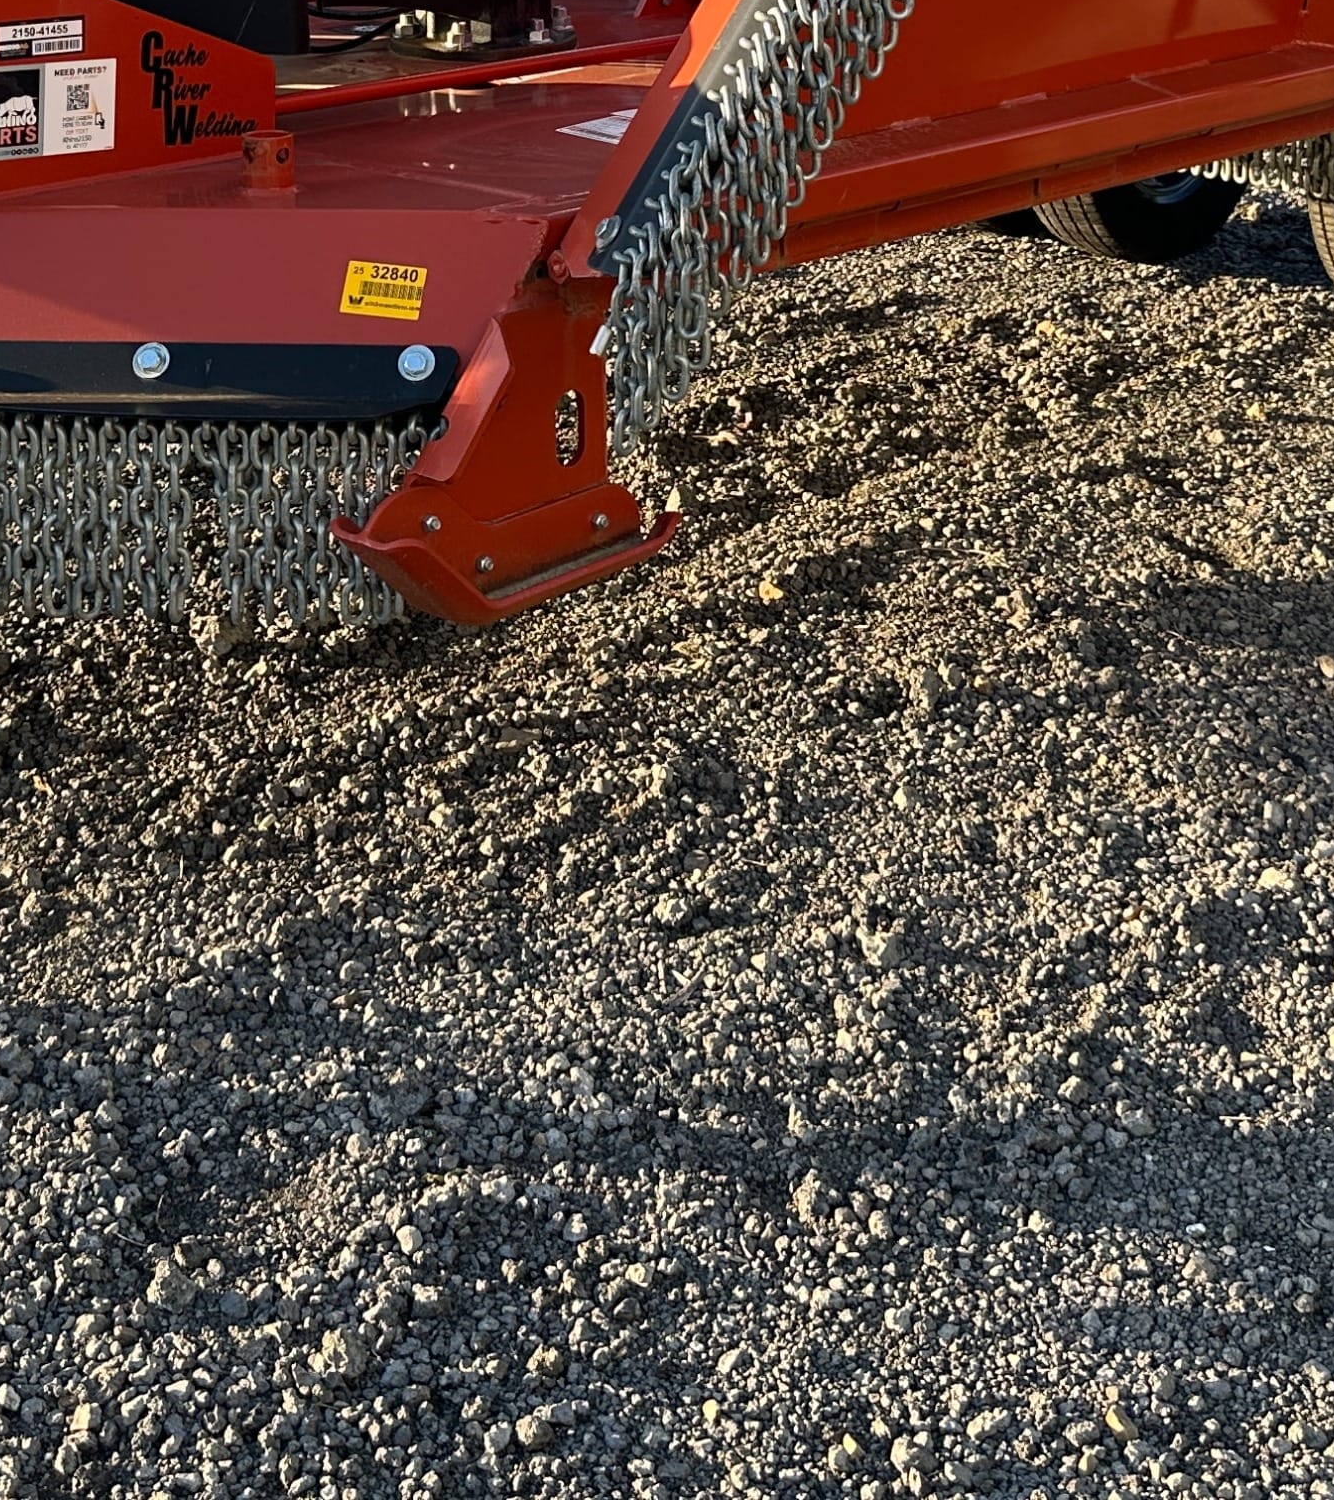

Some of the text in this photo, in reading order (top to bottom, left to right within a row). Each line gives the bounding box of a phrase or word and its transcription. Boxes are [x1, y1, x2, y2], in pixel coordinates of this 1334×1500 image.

[12, 24, 68, 38] 2150-41455
[141, 30, 209, 73] Cache
[54, 65, 107, 77] NEED PARTS?
[151, 67, 212, 110] River
[164, 103, 258, 147] Welding
[353, 265, 419, 283] 25 32840
